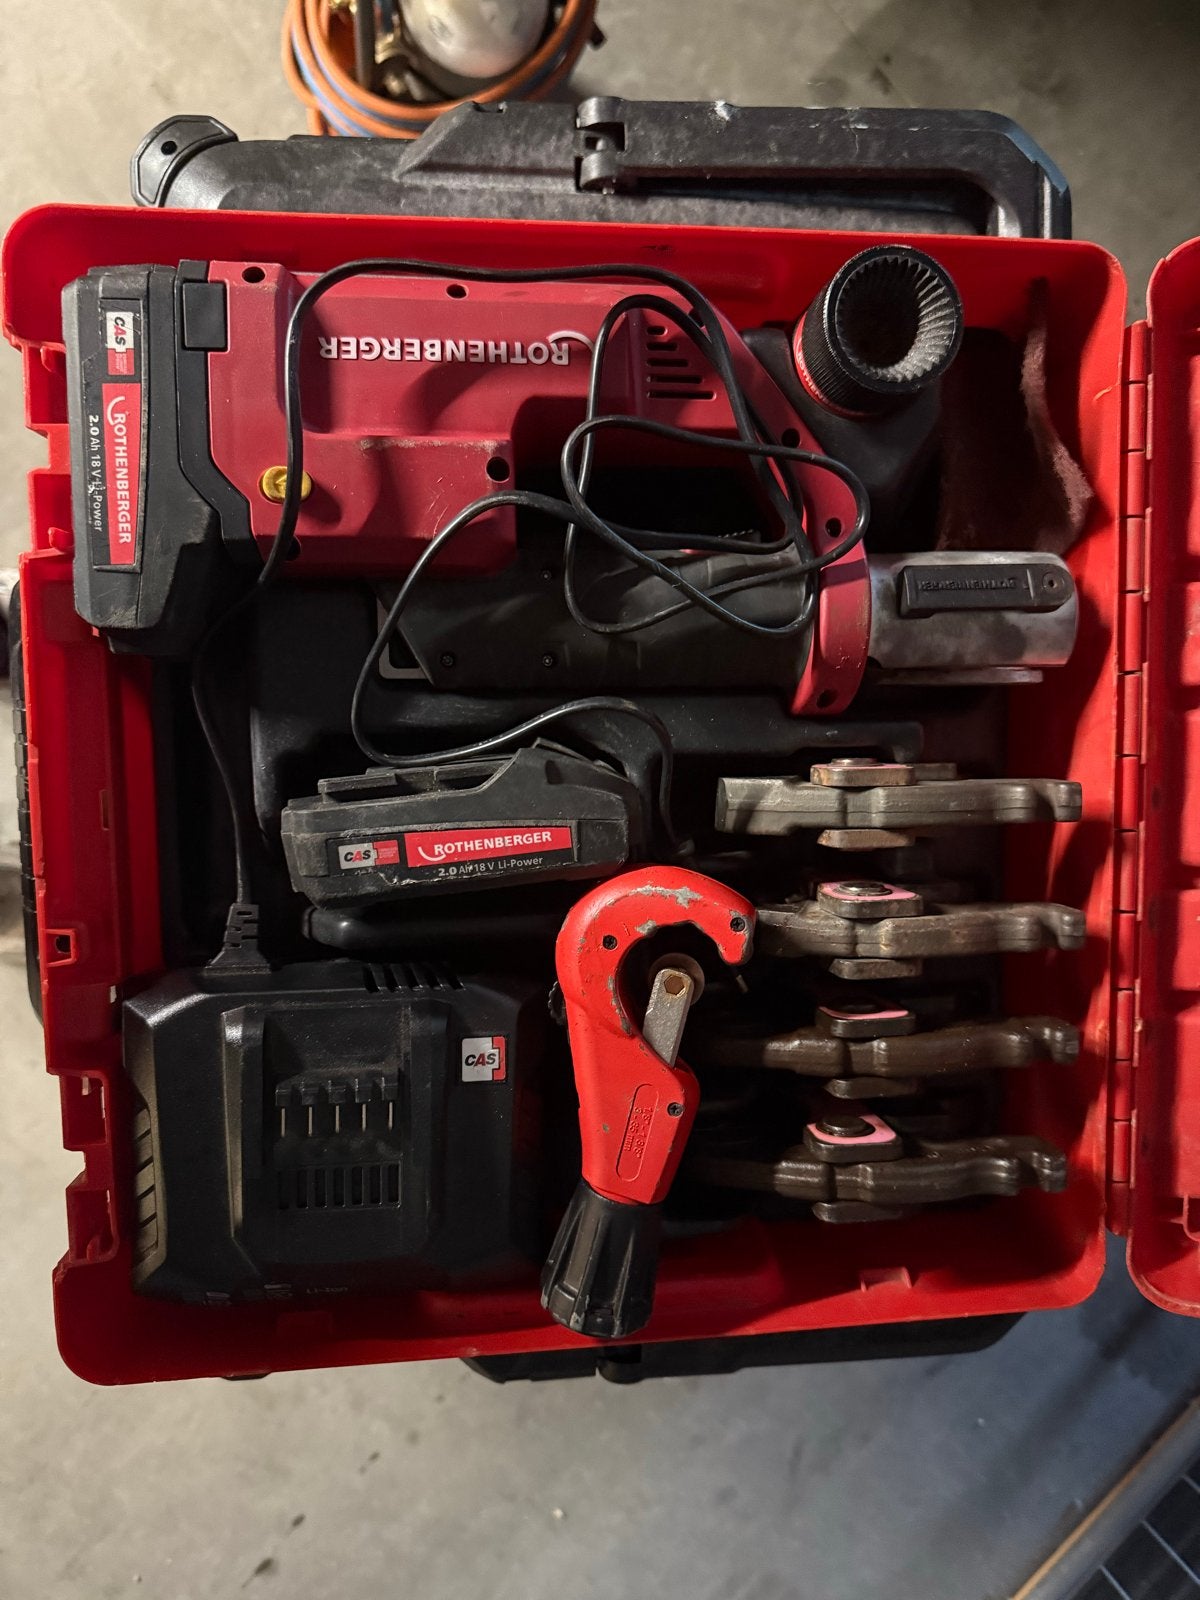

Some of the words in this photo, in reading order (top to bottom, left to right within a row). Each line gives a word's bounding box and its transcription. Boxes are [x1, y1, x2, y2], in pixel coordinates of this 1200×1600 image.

[113, 316, 127, 346] CAS
[317, 335, 570, 366] ROTHENBERGER
[88, 415, 100, 436] 2.0
[90, 437, 101, 451] Ah
[91, 454, 102, 468] 18
[91, 469, 102, 478] V
[112, 413, 132, 544] ROTHENBERGER
[433, 831, 553, 856] ROTHENBERGER
[343, 849, 372, 863] CAS
[438, 866, 458, 877] 2.0
[458, 863, 471, 875] Ah
[475, 861, 486, 872] 18
[487, 861, 496, 871] V
[498, 857, 544, 870] Li-Power
[464, 1053, 497, 1067] CAS
